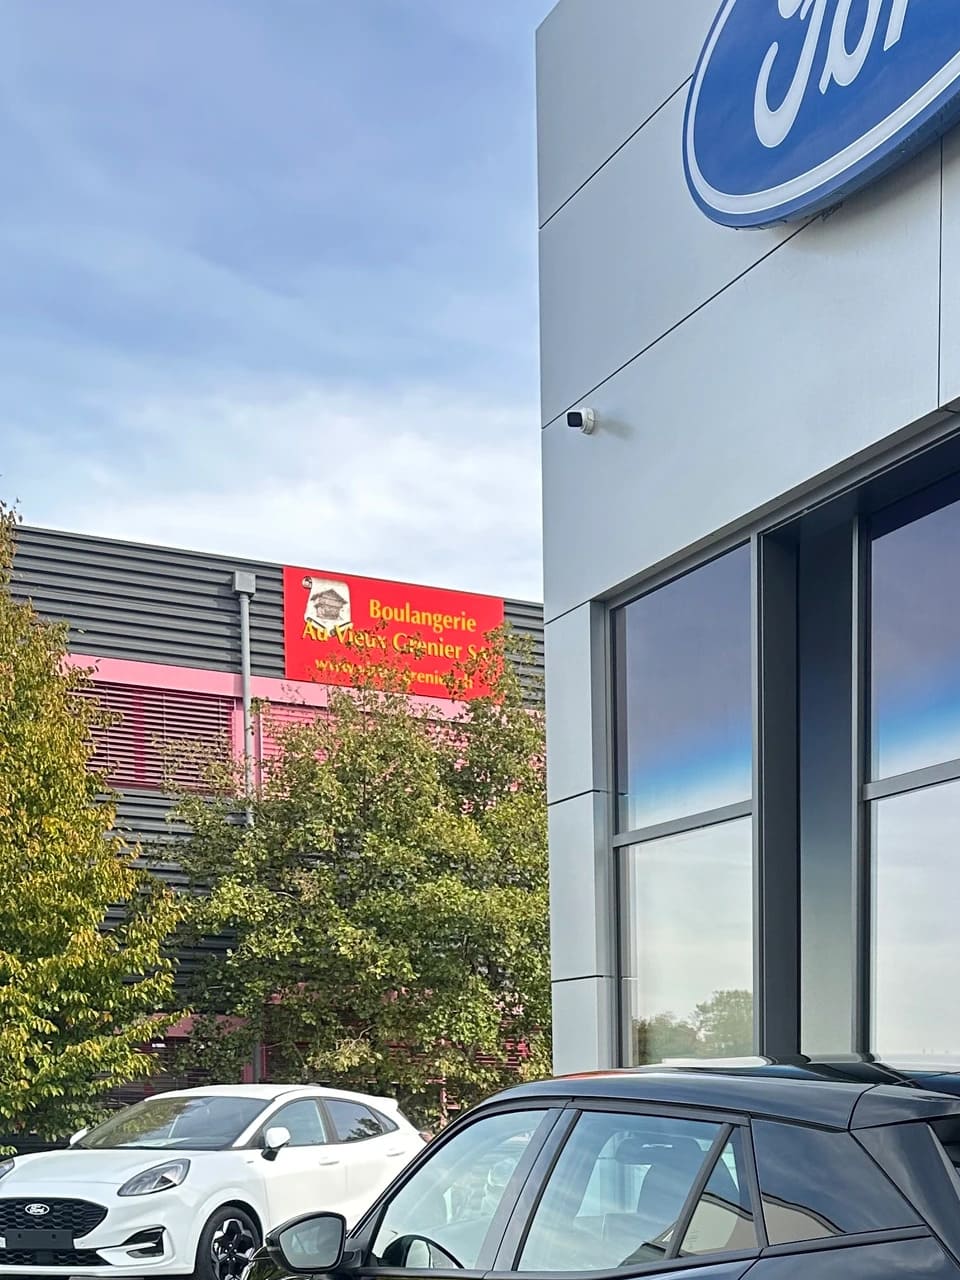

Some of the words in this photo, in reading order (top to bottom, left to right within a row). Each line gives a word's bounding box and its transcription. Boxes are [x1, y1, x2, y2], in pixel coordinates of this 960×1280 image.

[369, 599, 477, 633] Boulangerie
[302, 620, 329, 642] Au
[335, 623, 388, 649] Vieux
[392, 632, 463, 659] Grenier
